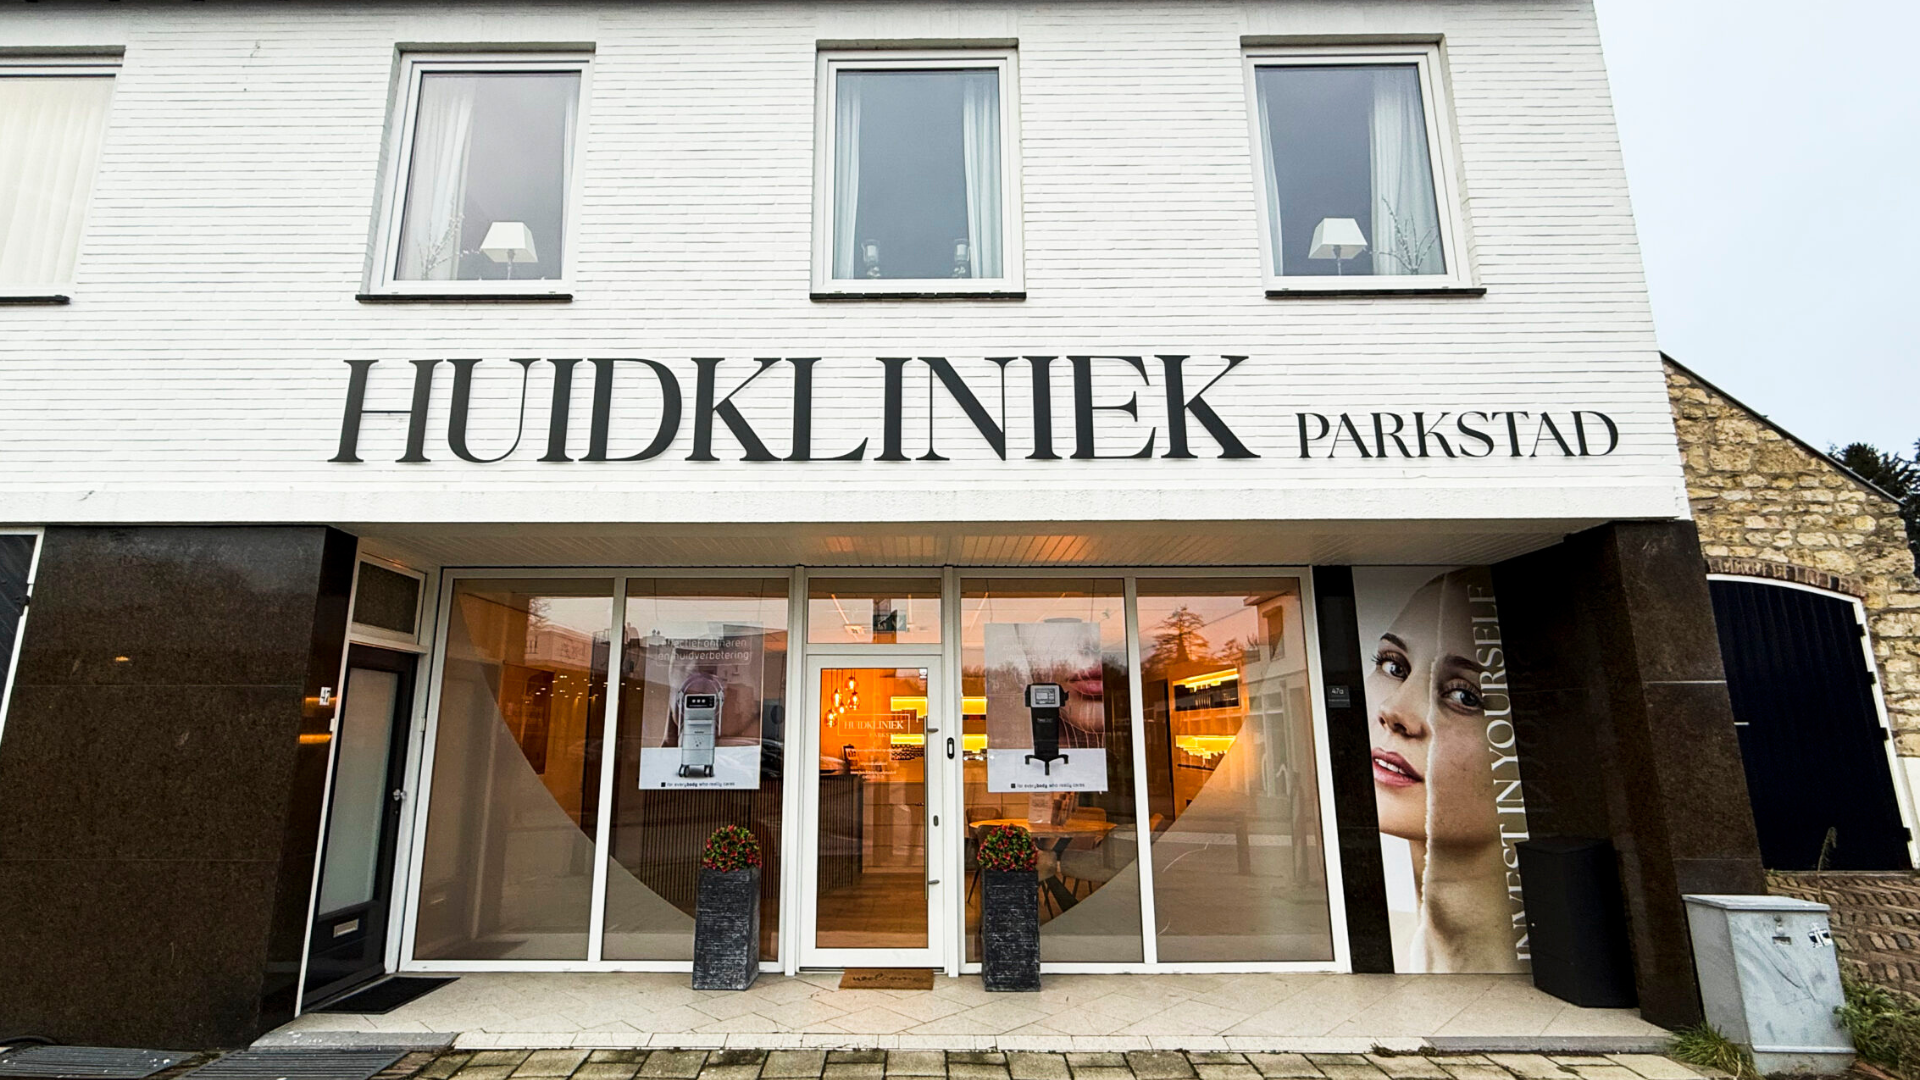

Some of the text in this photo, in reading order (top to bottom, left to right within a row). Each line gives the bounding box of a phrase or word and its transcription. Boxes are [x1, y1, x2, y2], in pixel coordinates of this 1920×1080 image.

[328, 355, 1619, 462] HUIDKLINIEK PARKSTAD
[1467, 584, 1519, 771] YOURSELF
[844, 720, 904, 730] HUIDKLINIEK
[1493, 779, 1526, 815] IN
